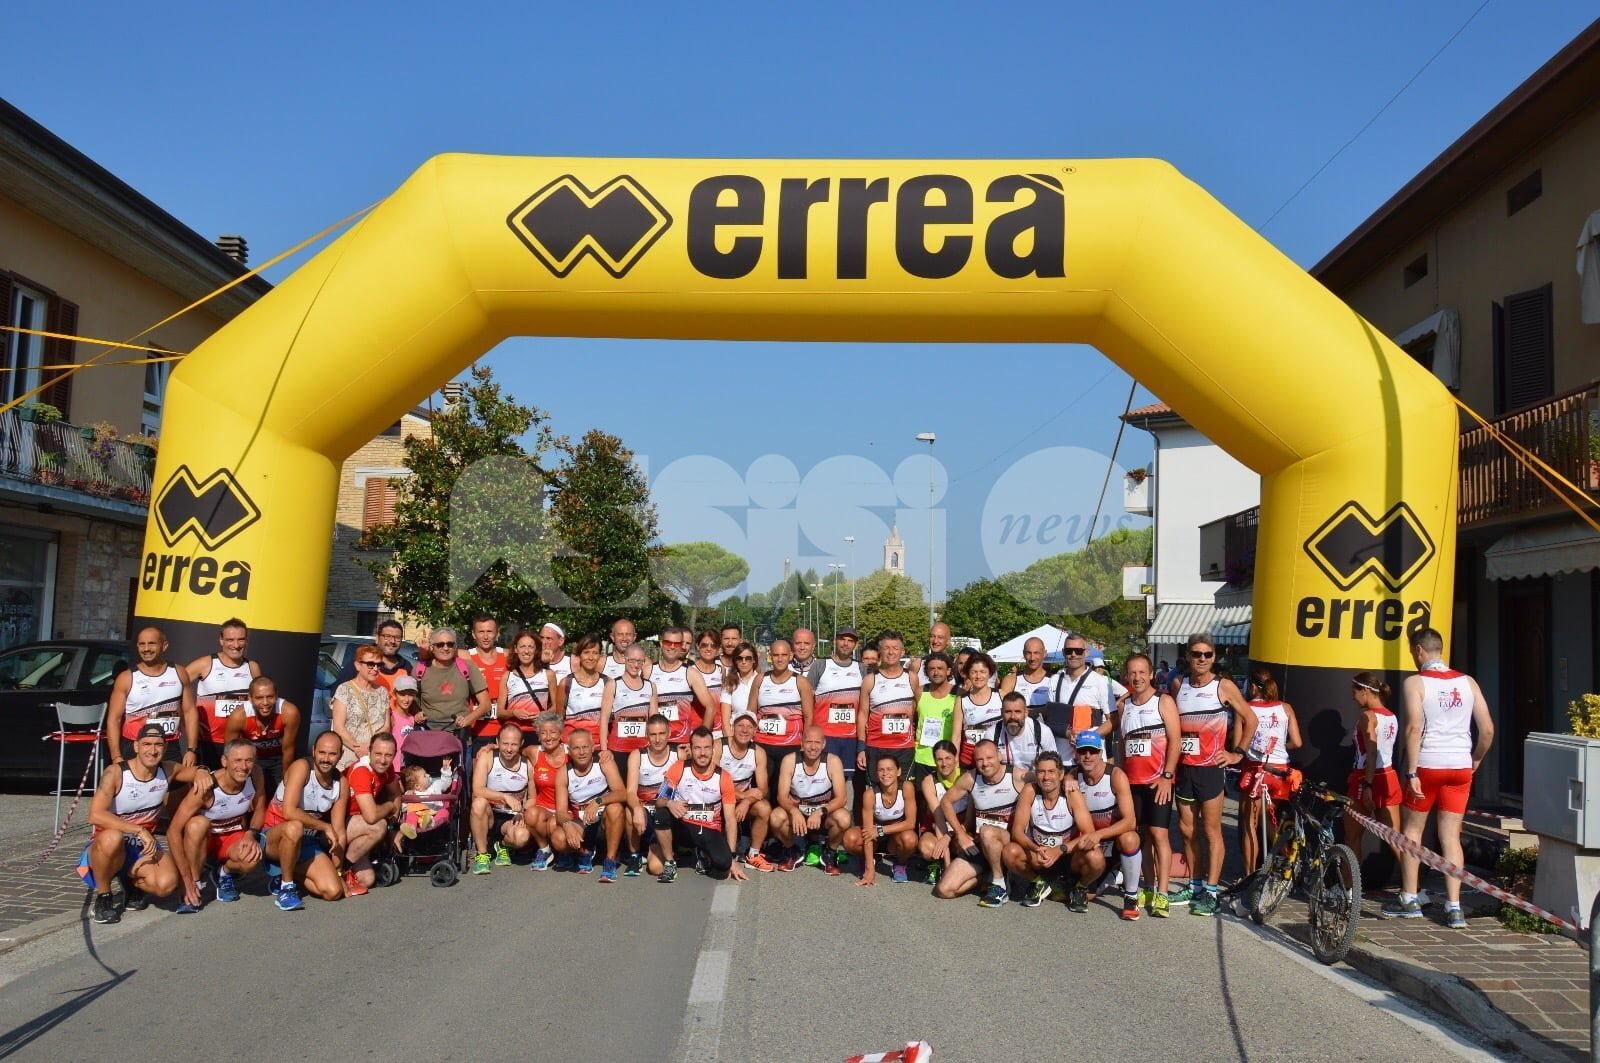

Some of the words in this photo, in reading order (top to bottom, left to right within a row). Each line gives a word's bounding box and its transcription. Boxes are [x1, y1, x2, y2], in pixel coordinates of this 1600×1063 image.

[834, 711, 852, 721] 309
[623, 725, 642, 735] 307
[763, 722, 779, 733] 321
[887, 722, 906, 732] 313
[1128, 743, 1145, 754] 320
